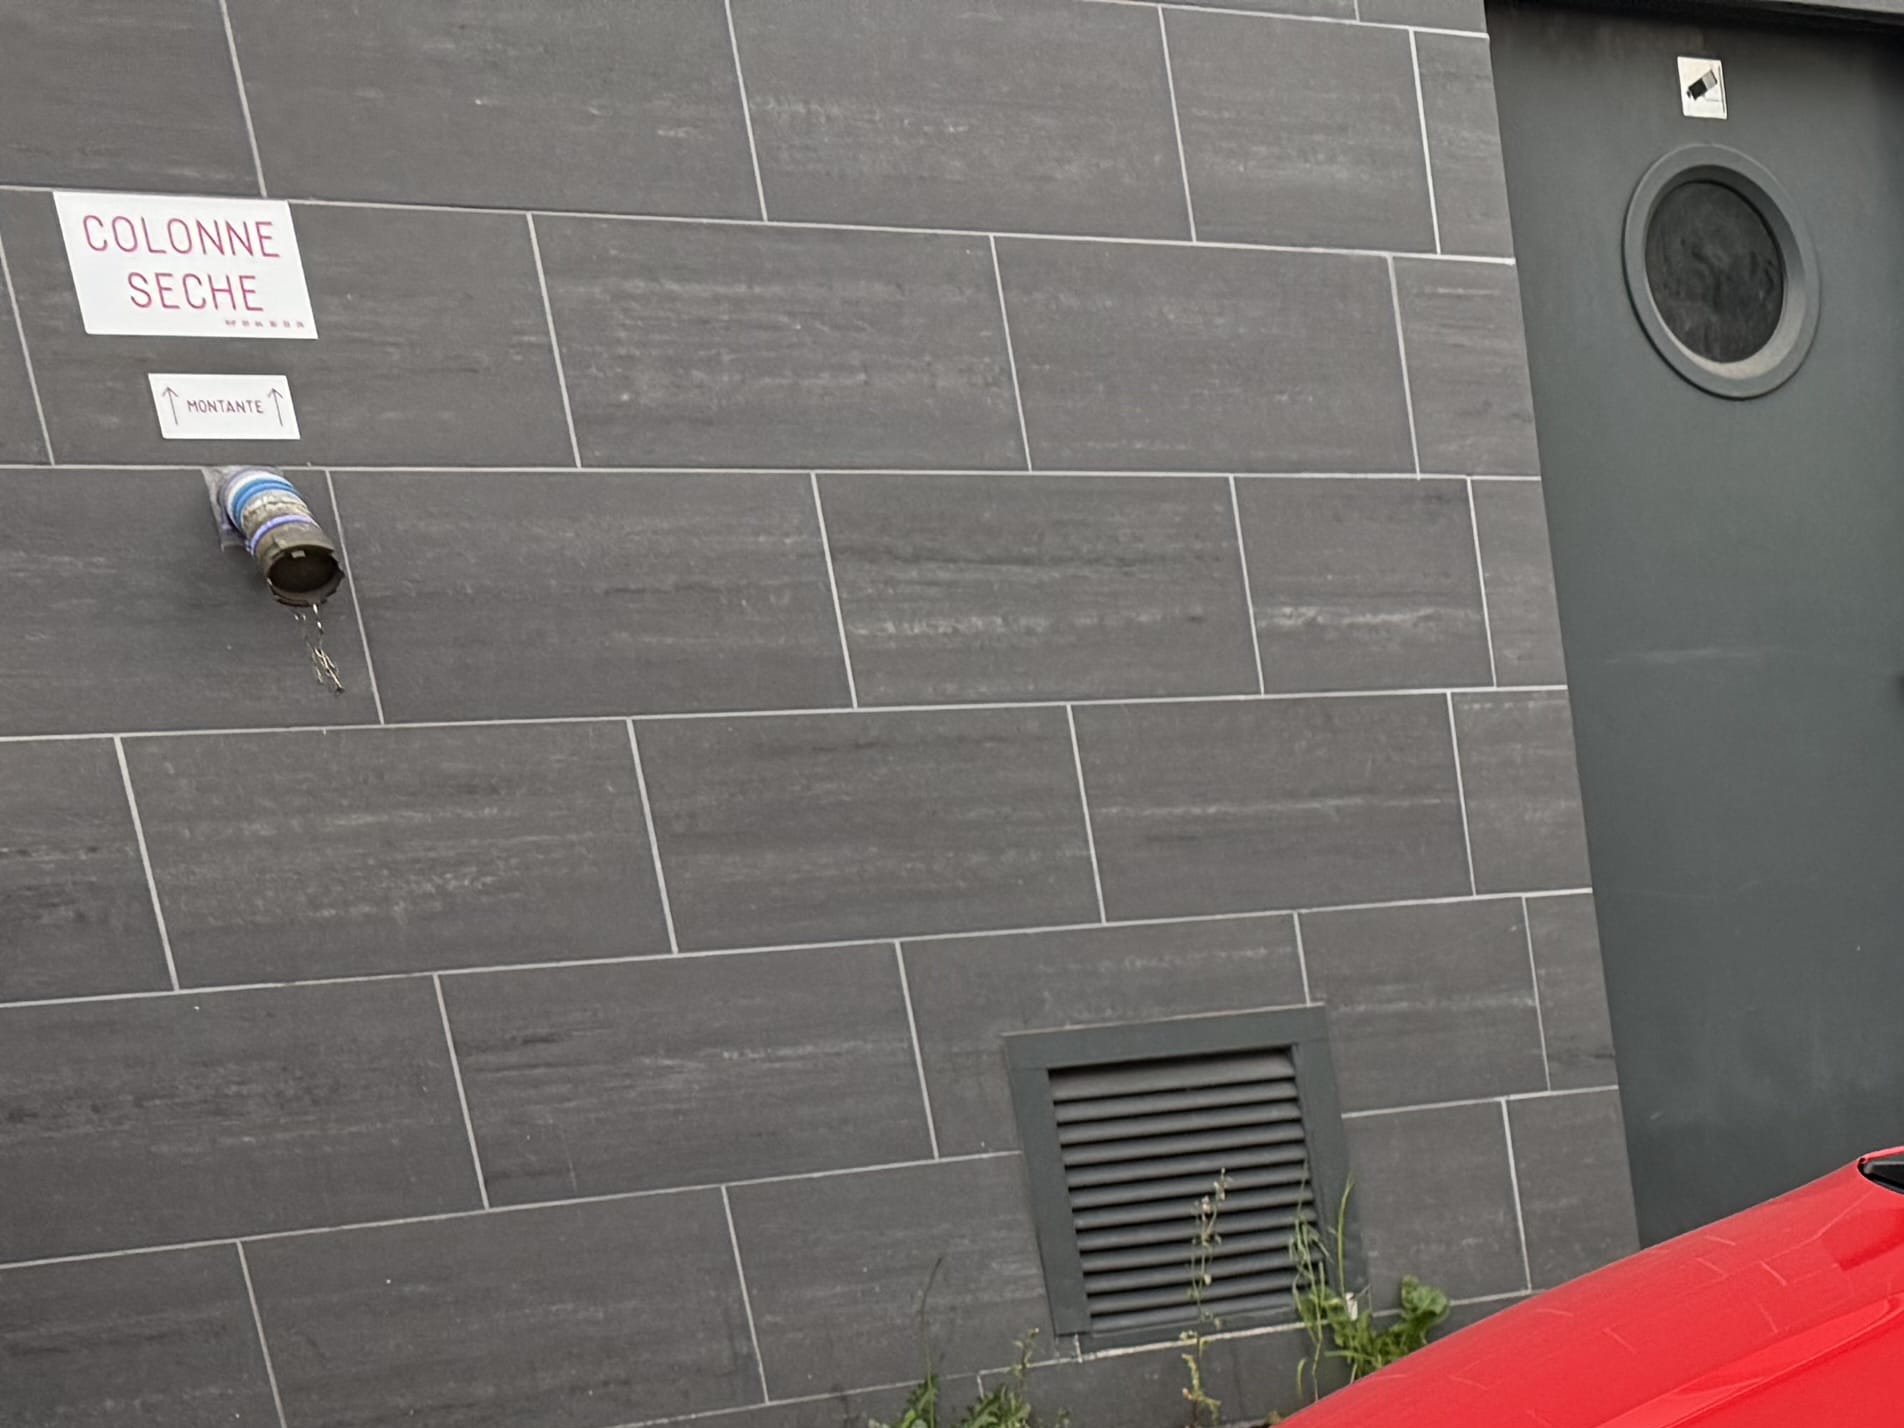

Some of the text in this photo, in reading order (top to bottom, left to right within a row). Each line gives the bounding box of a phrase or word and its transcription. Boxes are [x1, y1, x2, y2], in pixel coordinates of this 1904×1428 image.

[83, 214, 280, 258] COLONNE
[128, 271, 264, 311] SECHE
[186, 399, 264, 415] MONTANTE
